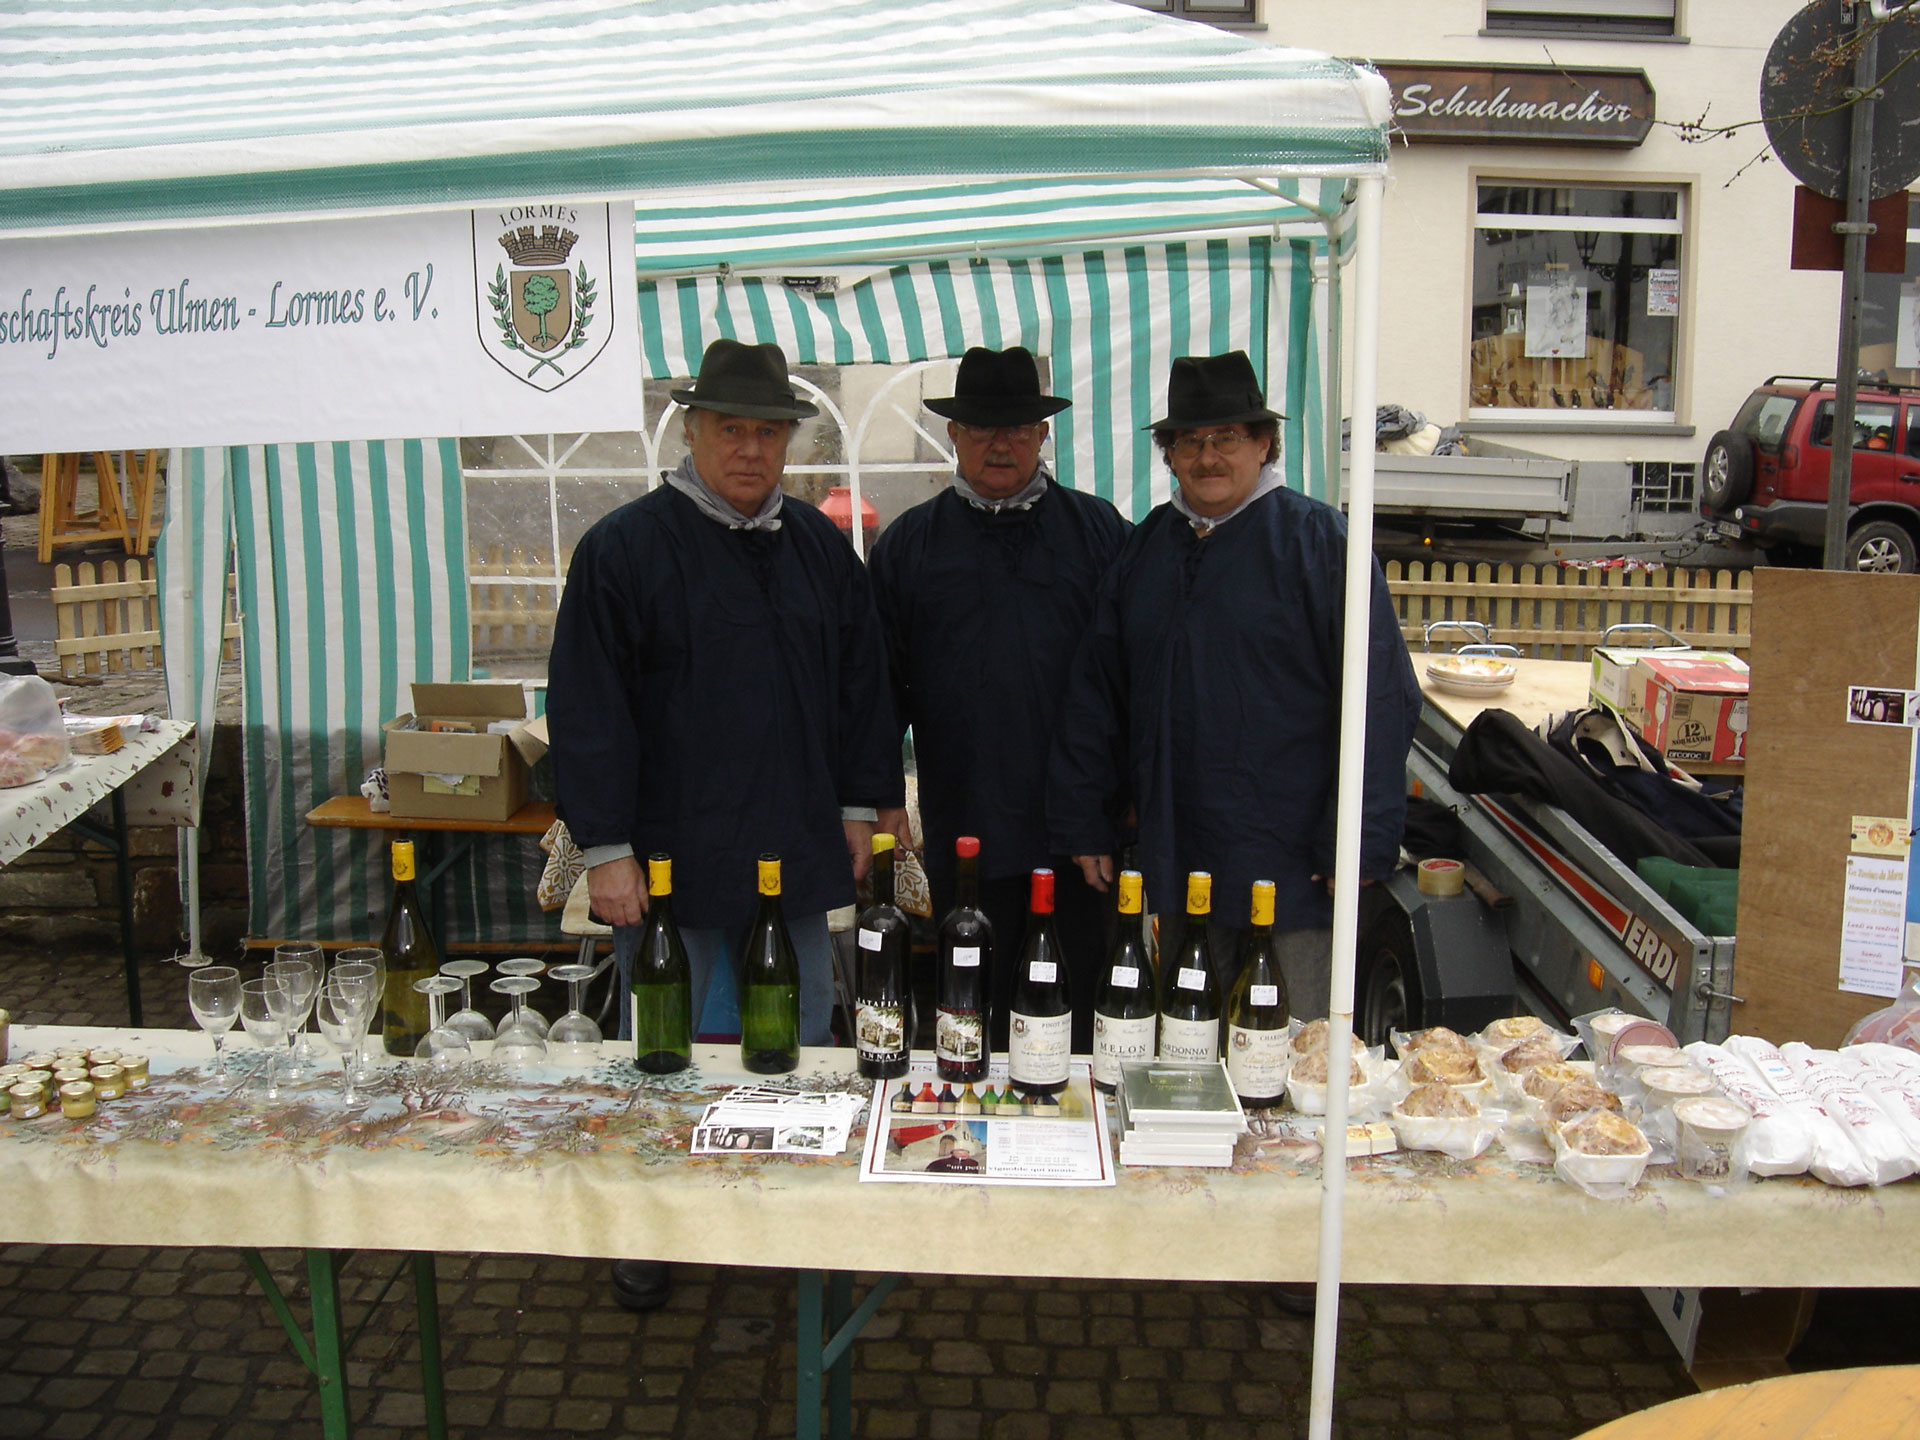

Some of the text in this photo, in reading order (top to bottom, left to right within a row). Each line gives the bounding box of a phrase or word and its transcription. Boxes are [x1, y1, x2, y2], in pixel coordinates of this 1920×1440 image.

[1397, 84, 1632, 122] Schuhmacher
[500, 205, 578, 227] LORMES
[150, 278, 240, 335] Ulmen
[265, 281, 365, 328] Lormes
[374, 287, 396, 322] e.
[404, 262, 438, 321] V.
[1684, 722, 1701, 737] 12
[1671, 735, 1712, 745] NORMANDIE
[1668, 752, 1702, 760] arcoroc
[1100, 1041, 1147, 1054] MELON
